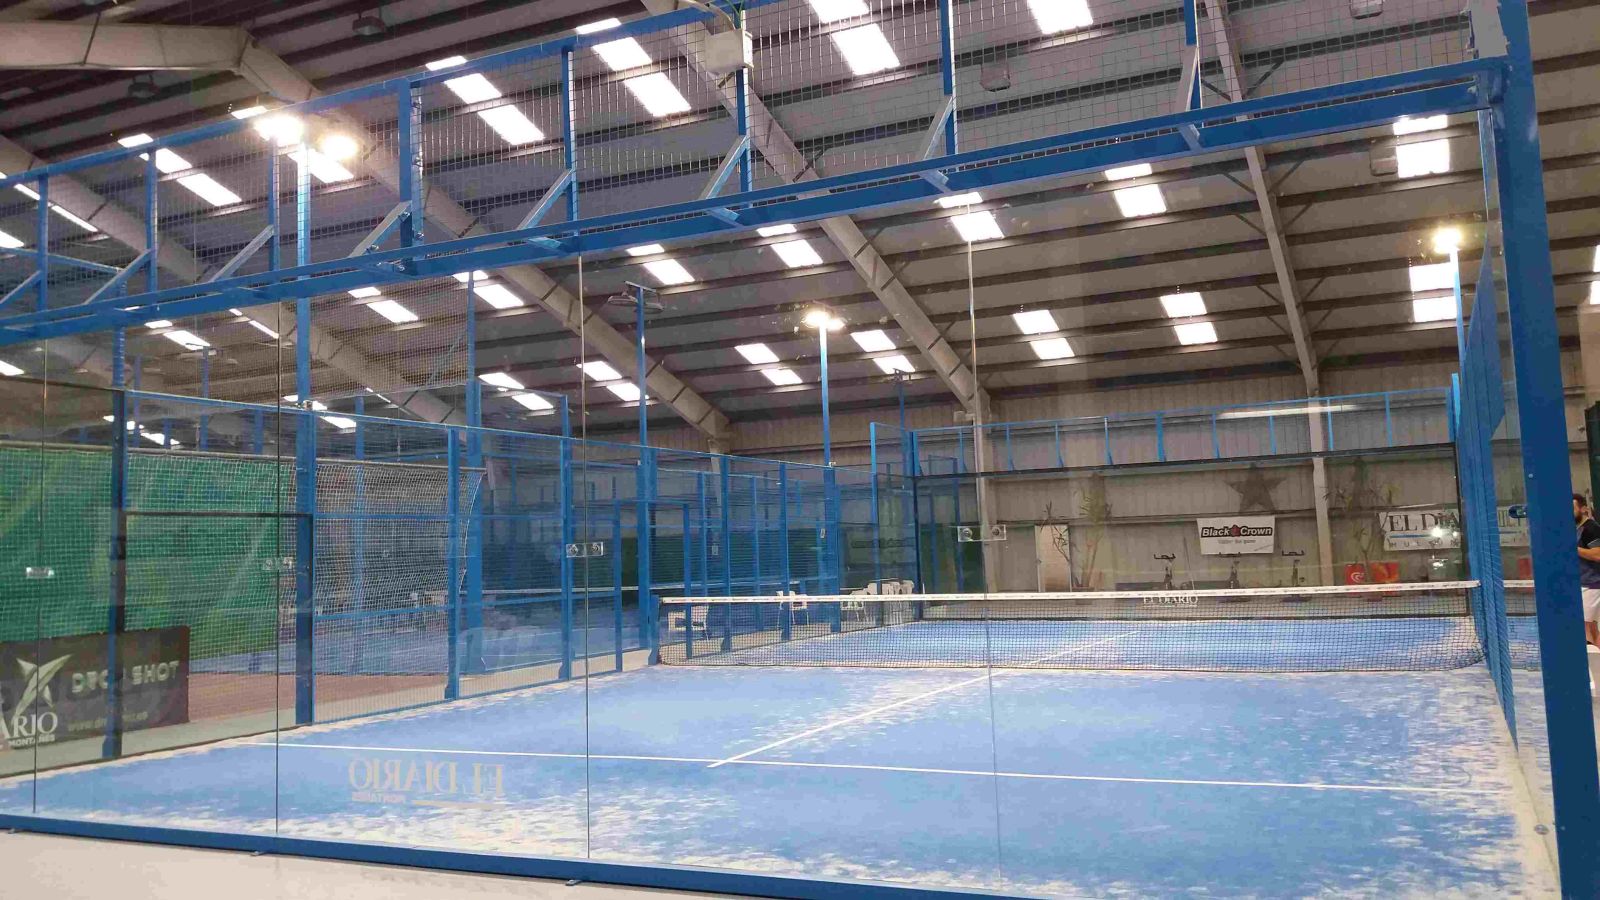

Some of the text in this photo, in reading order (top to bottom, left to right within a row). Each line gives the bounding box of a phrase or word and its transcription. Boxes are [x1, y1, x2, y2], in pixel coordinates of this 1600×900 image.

[1202, 526, 1272, 537] Black Crown
[1388, 514, 1418, 532] EL
[131, 660, 180, 686] SHOT
